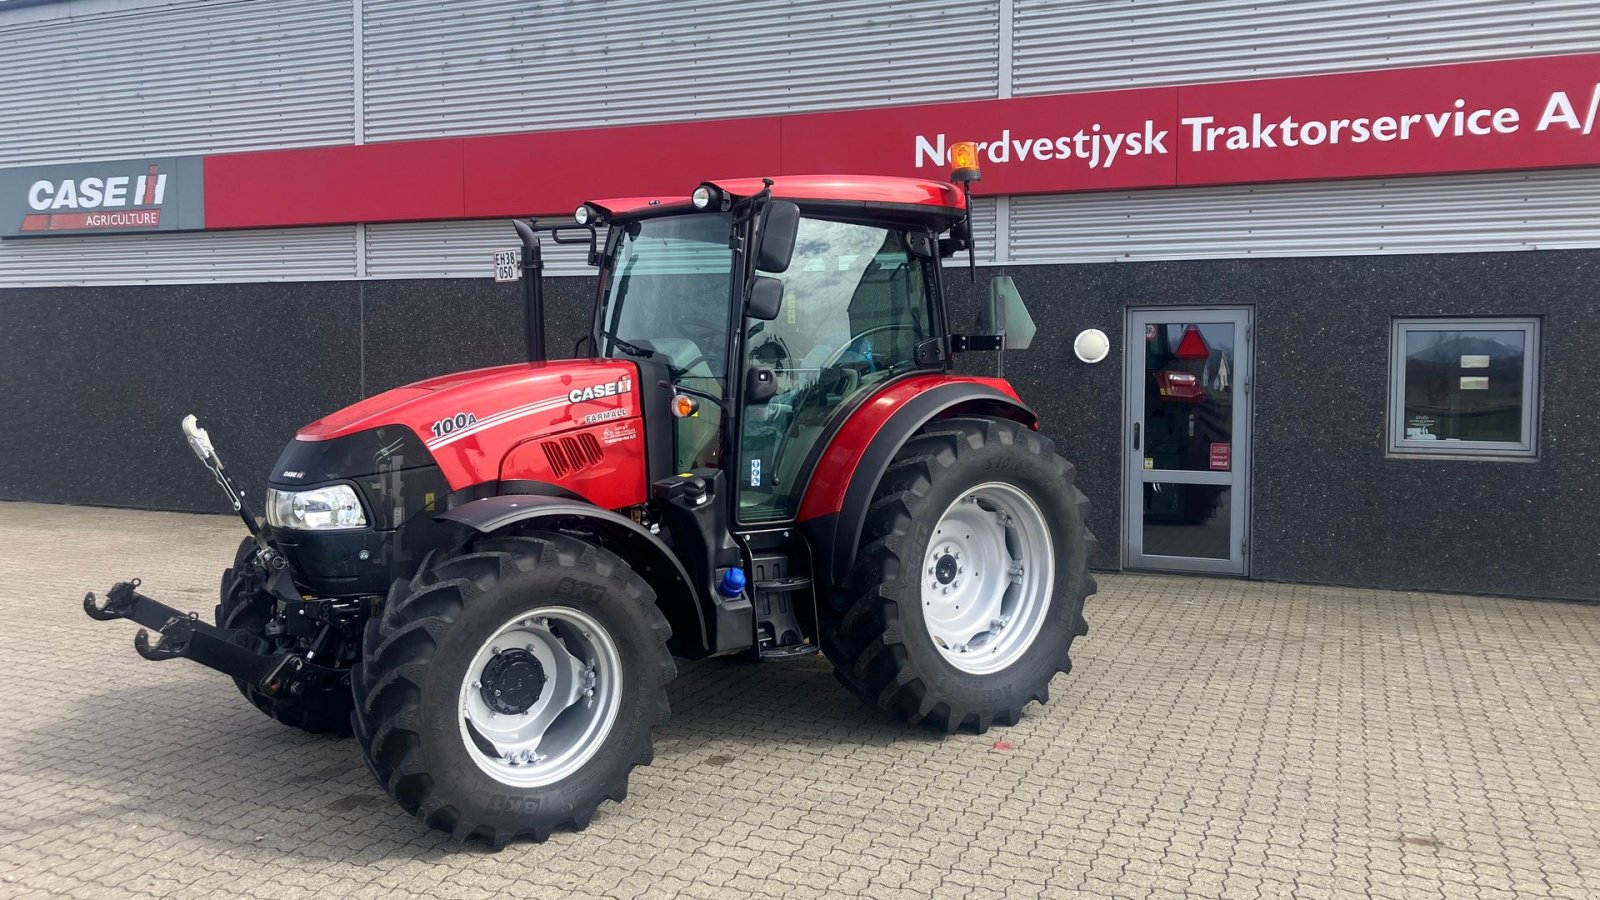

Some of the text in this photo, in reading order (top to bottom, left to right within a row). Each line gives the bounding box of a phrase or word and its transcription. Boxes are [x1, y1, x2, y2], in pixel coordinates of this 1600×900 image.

[915, 120, 1169, 168] Nrdvestjysk
[1181, 98, 1520, 152] Traktorservice
[28, 176, 129, 211] CASE
[86, 212, 157, 226] AGRICULTURE
[495, 251, 515, 266] EH38
[499, 266, 513, 279] 050
[569, 382, 616, 403] CASE
[432, 413, 477, 437] 100A
[585, 408, 627, 424] FARMALL
